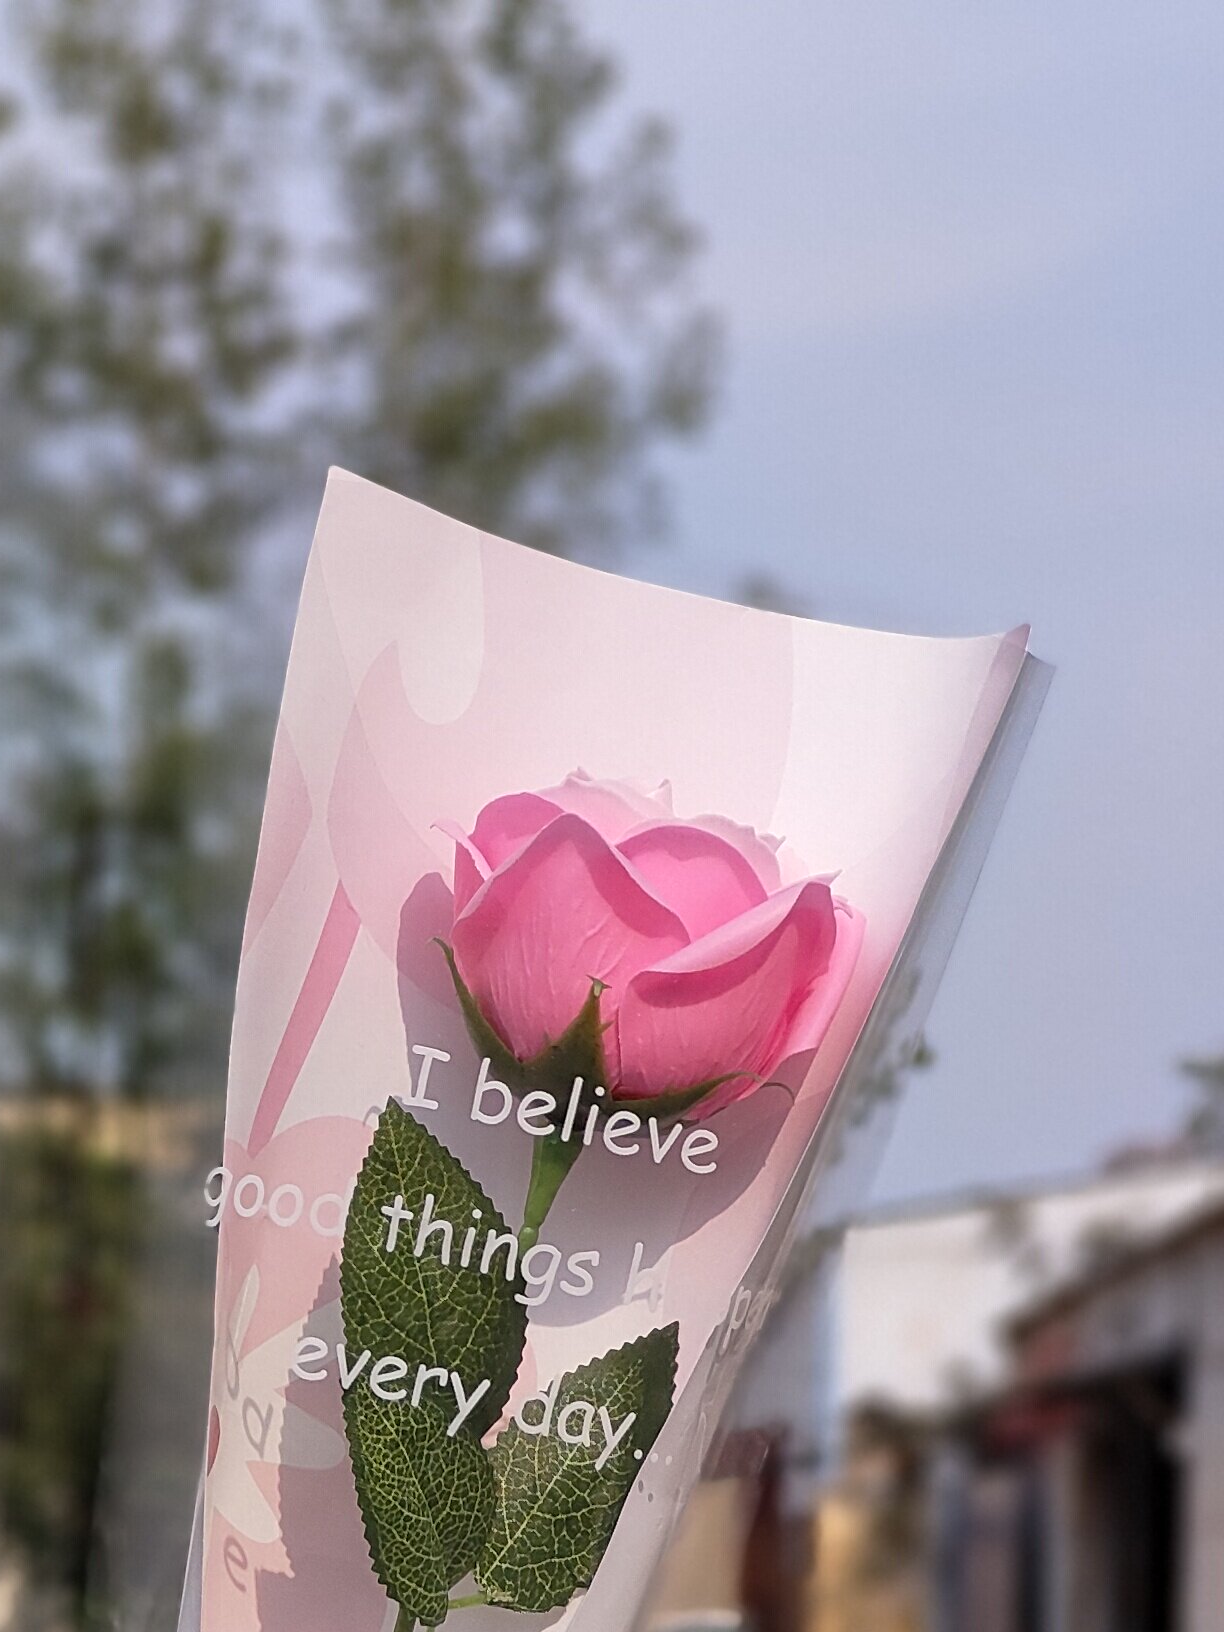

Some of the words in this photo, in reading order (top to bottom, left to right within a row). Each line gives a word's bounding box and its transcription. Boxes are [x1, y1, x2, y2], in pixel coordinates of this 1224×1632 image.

[400, 1045, 450, 1110] I
[470, 1057, 719, 1174] believe
[203, 1166, 358, 1238] good
[380, 1193, 599, 1304] things
[290, 1335, 490, 1437] every
